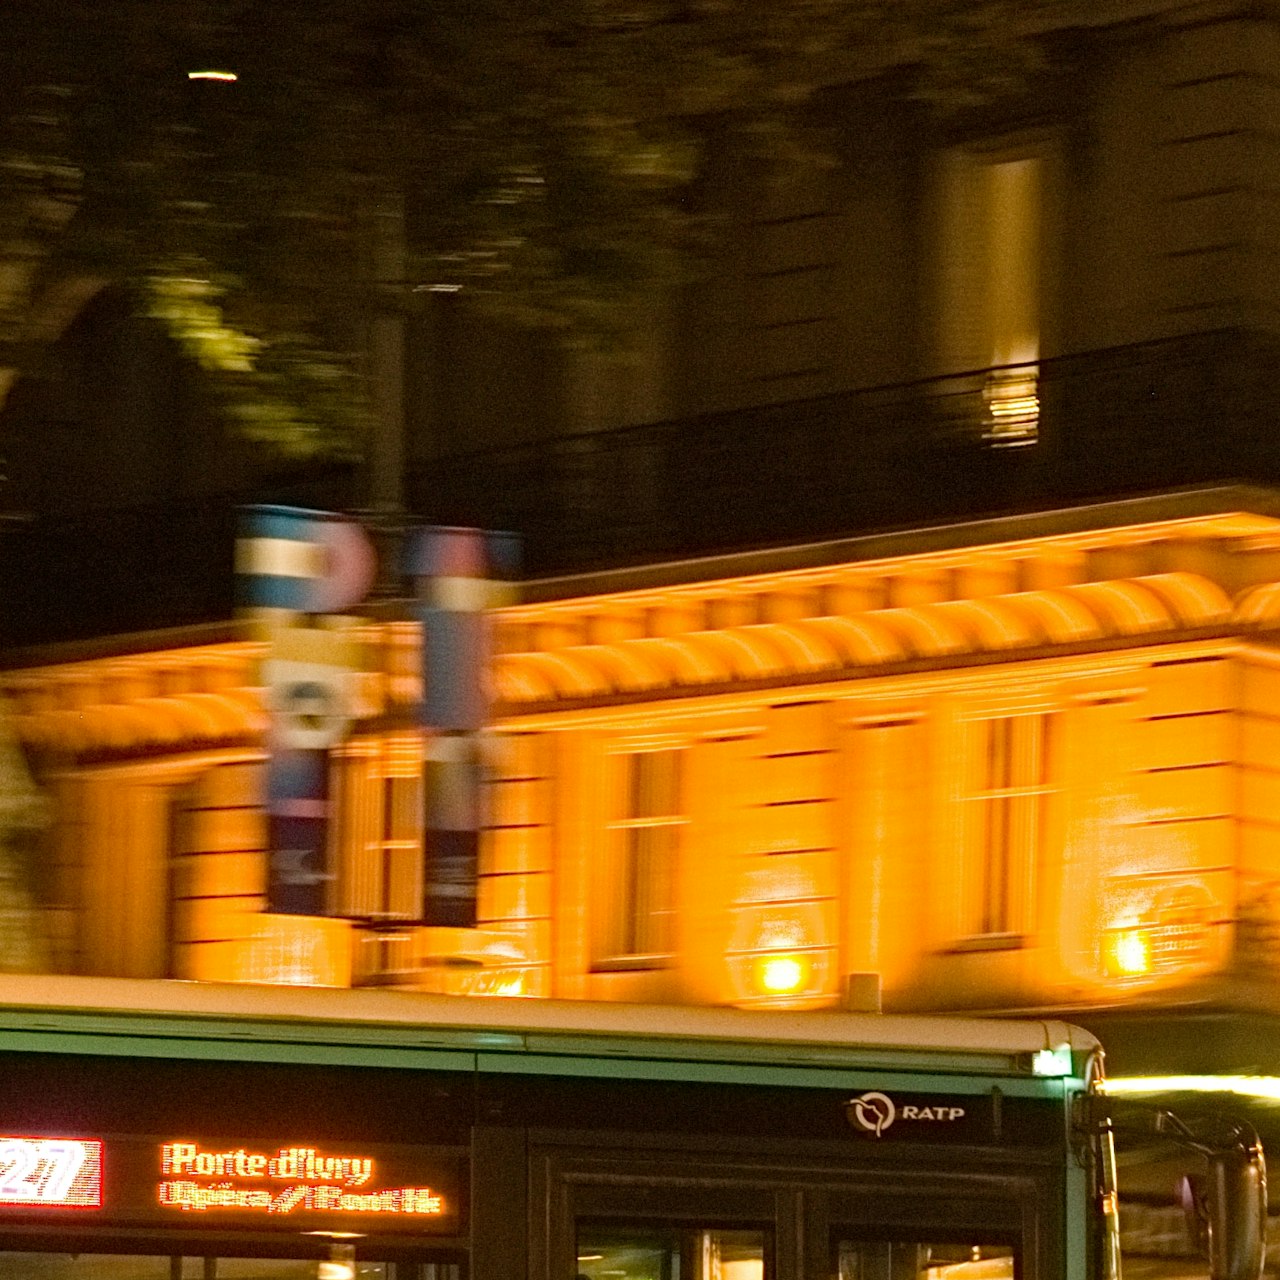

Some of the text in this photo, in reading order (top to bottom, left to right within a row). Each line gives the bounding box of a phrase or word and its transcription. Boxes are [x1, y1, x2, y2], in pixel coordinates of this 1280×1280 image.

[902, 1105, 965, 1121] RATP
[162, 1142, 373, 1186] Porte d'Ivry
